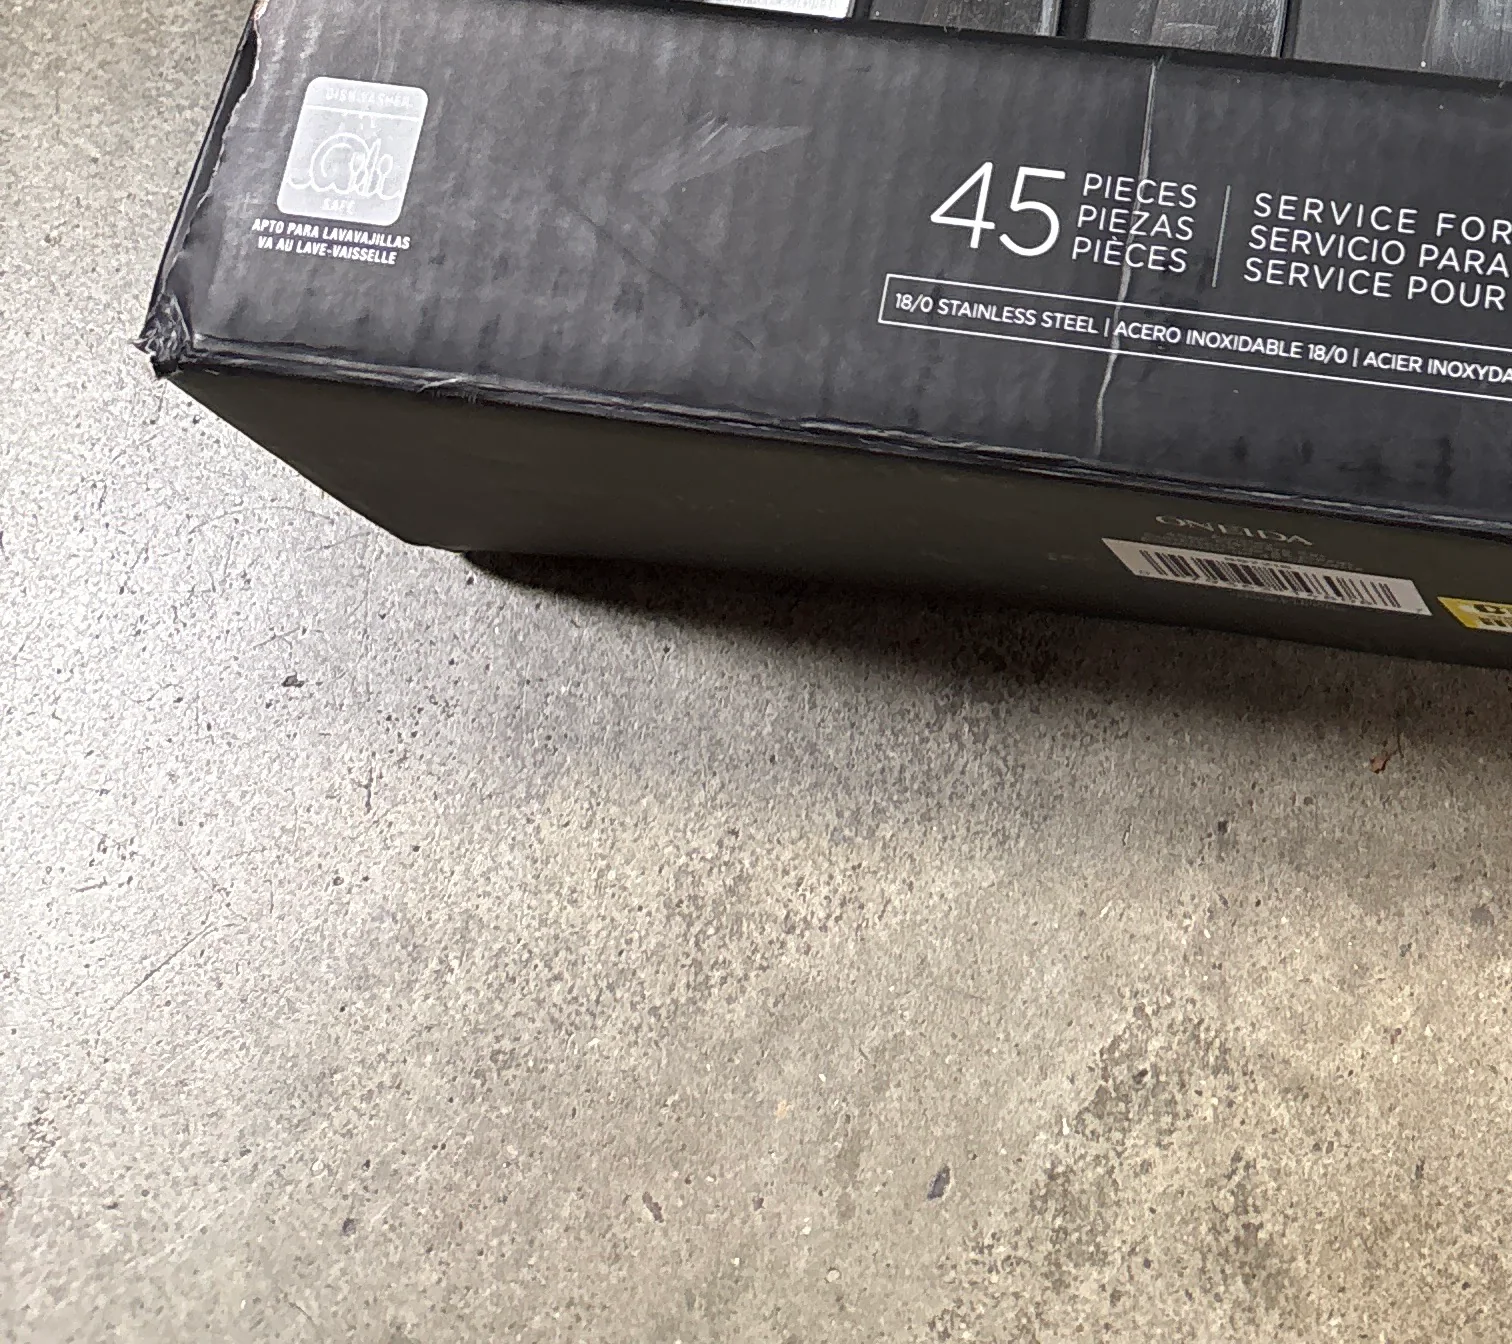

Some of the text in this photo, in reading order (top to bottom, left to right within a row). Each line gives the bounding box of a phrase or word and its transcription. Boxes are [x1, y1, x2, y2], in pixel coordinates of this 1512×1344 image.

[930, 161, 1065, 257] 45
[1082, 173, 1198, 208] PIECES
[252, 218, 410, 249] APTO PARA LAVAVAJILLAS
[1077, 205, 1195, 241] PIEZAS
[1253, 192, 1512, 245] SERVICE FOR
[257, 236, 397, 264] VA AU LAVE-VAISSELLE
[1071, 235, 1188, 273] PIÈCES
[1248, 224, 1510, 278] SERVICIO PARA
[1244, 257, 1506, 311] SERVICE POUR
[894, 292, 934, 313] 18/0
[937, 298, 1037, 326] STAINLESS
[1041, 313, 1099, 334] STEEL
[1113, 322, 1182, 343] ACERO
[1186, 330, 1303, 359] INOXIDABLE
[1308, 343, 1348, 364] 18/0
[1363, 352, 1422, 373] ACIER
